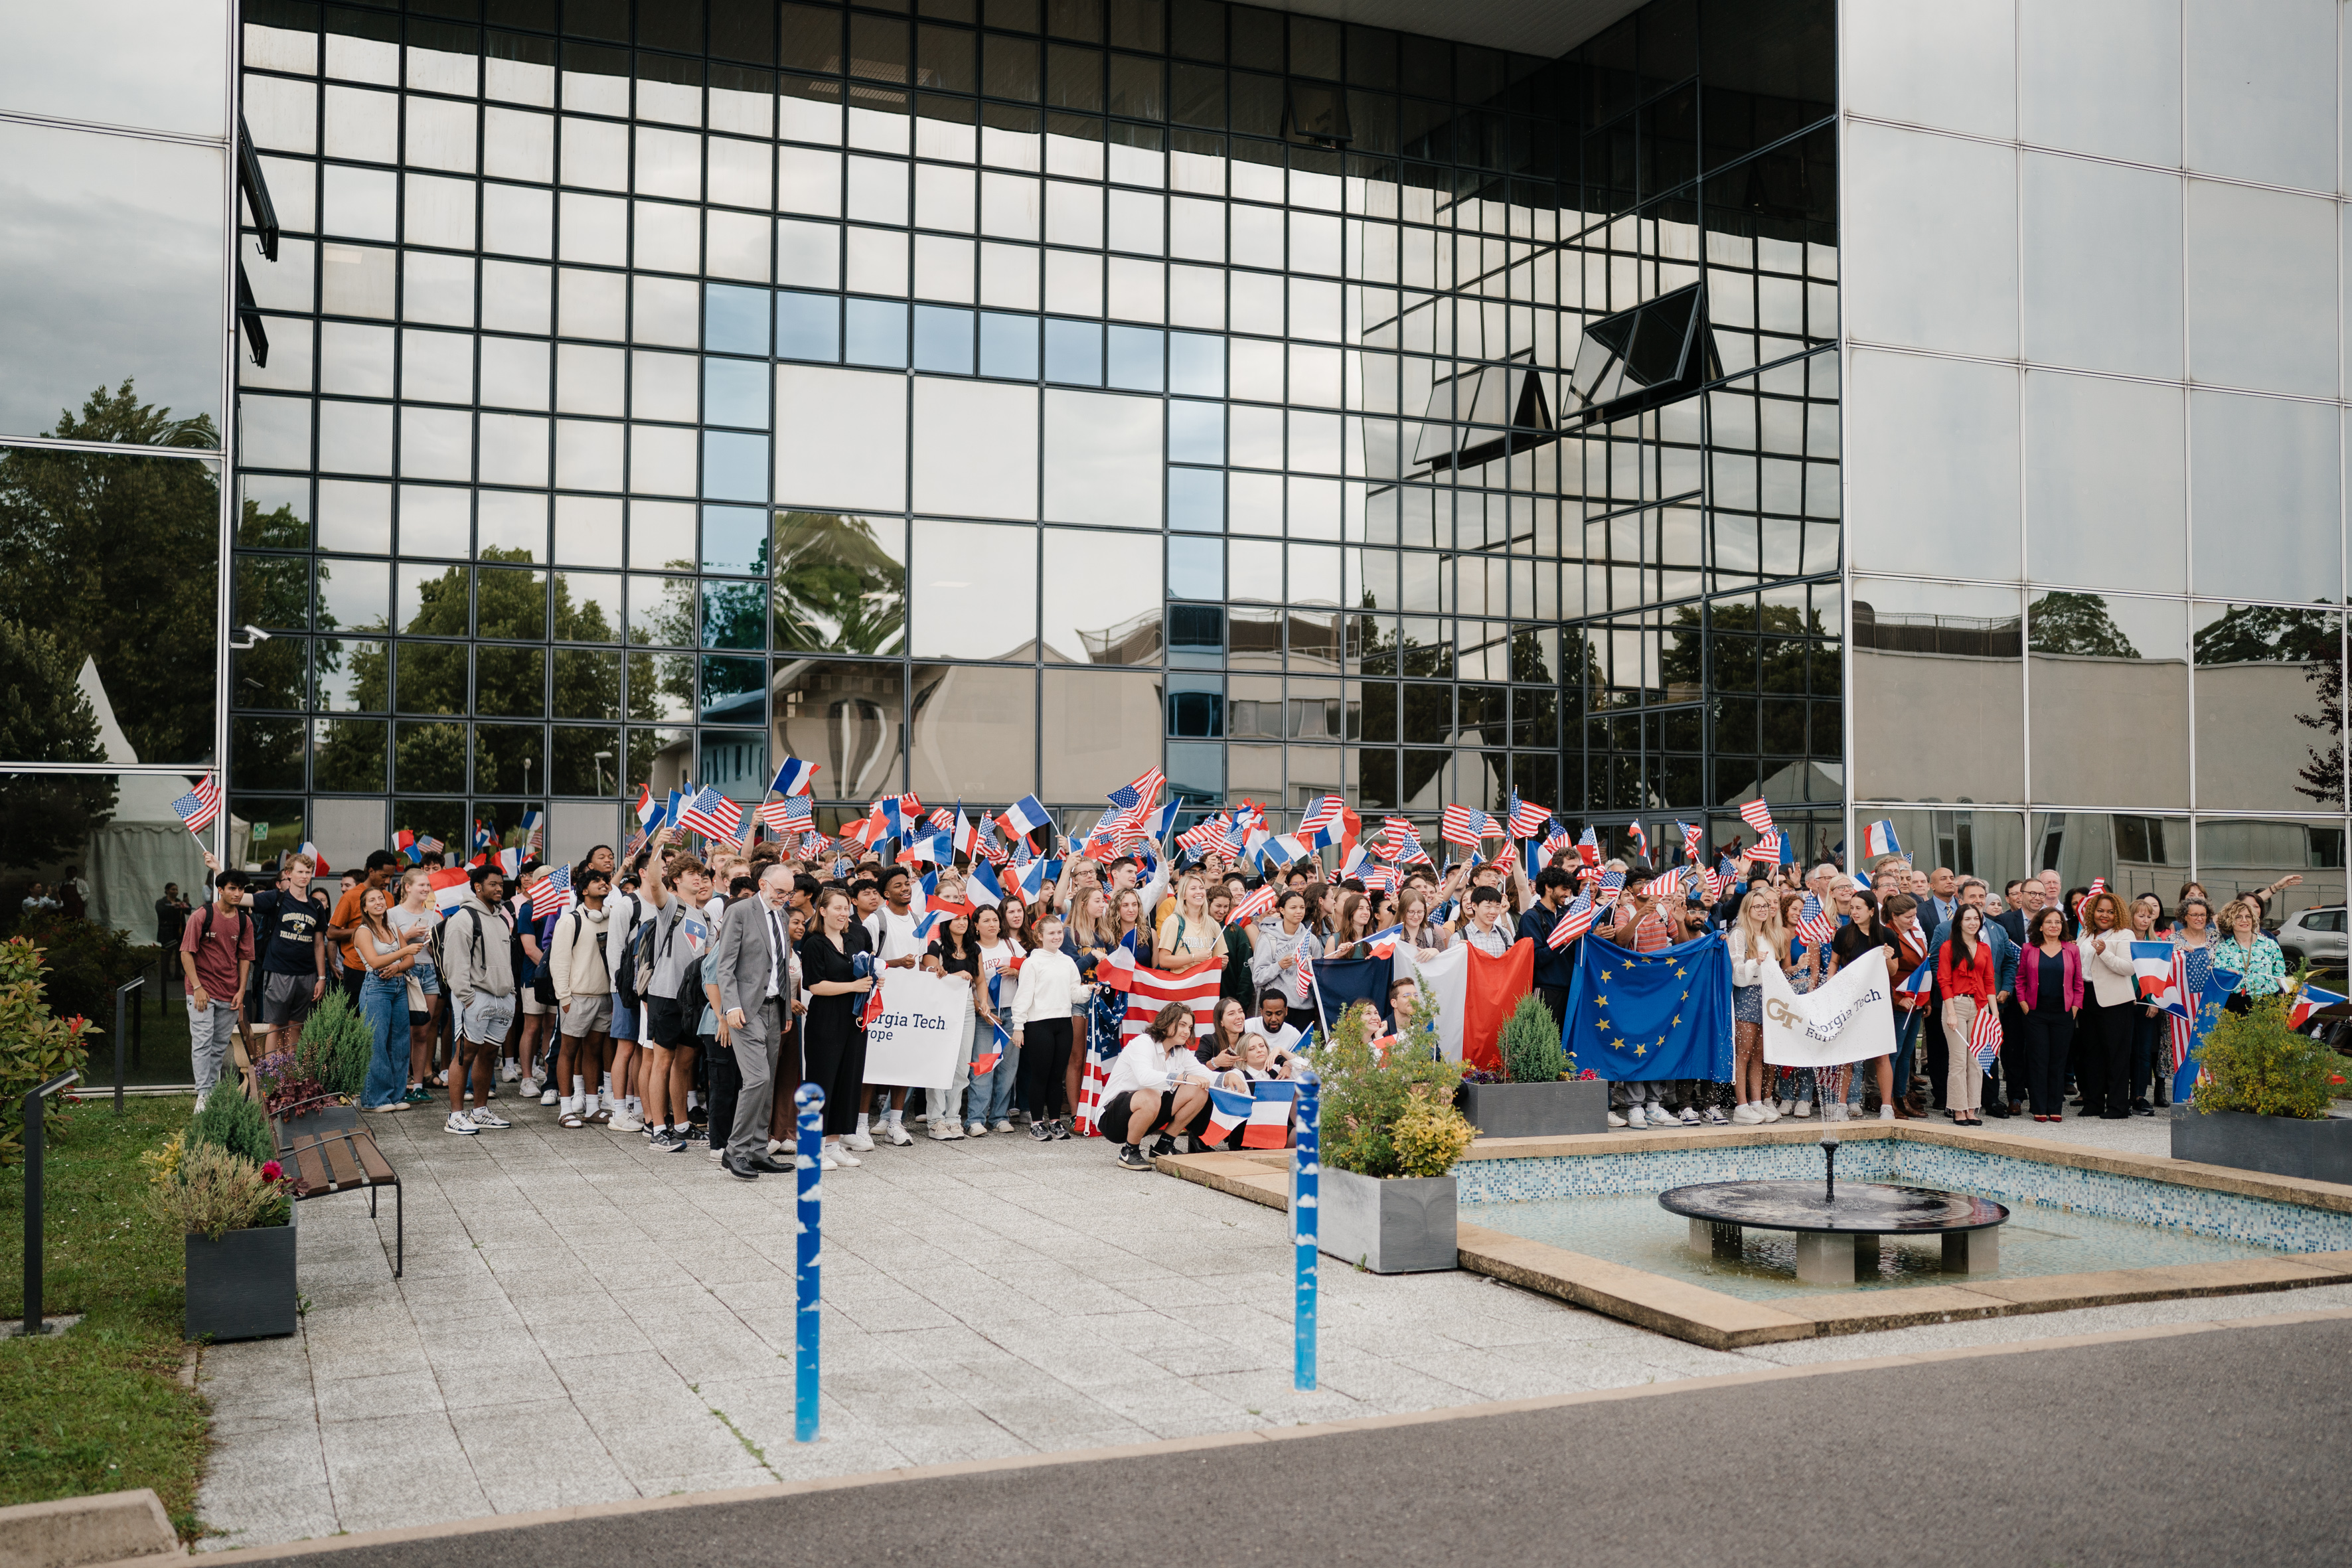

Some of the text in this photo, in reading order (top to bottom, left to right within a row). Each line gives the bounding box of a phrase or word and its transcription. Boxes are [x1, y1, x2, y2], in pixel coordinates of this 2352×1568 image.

[1853, 988, 1882, 1012] Tech
[913, 1013, 945, 1030] Tech
[1766, 998, 1804, 1030] GT
